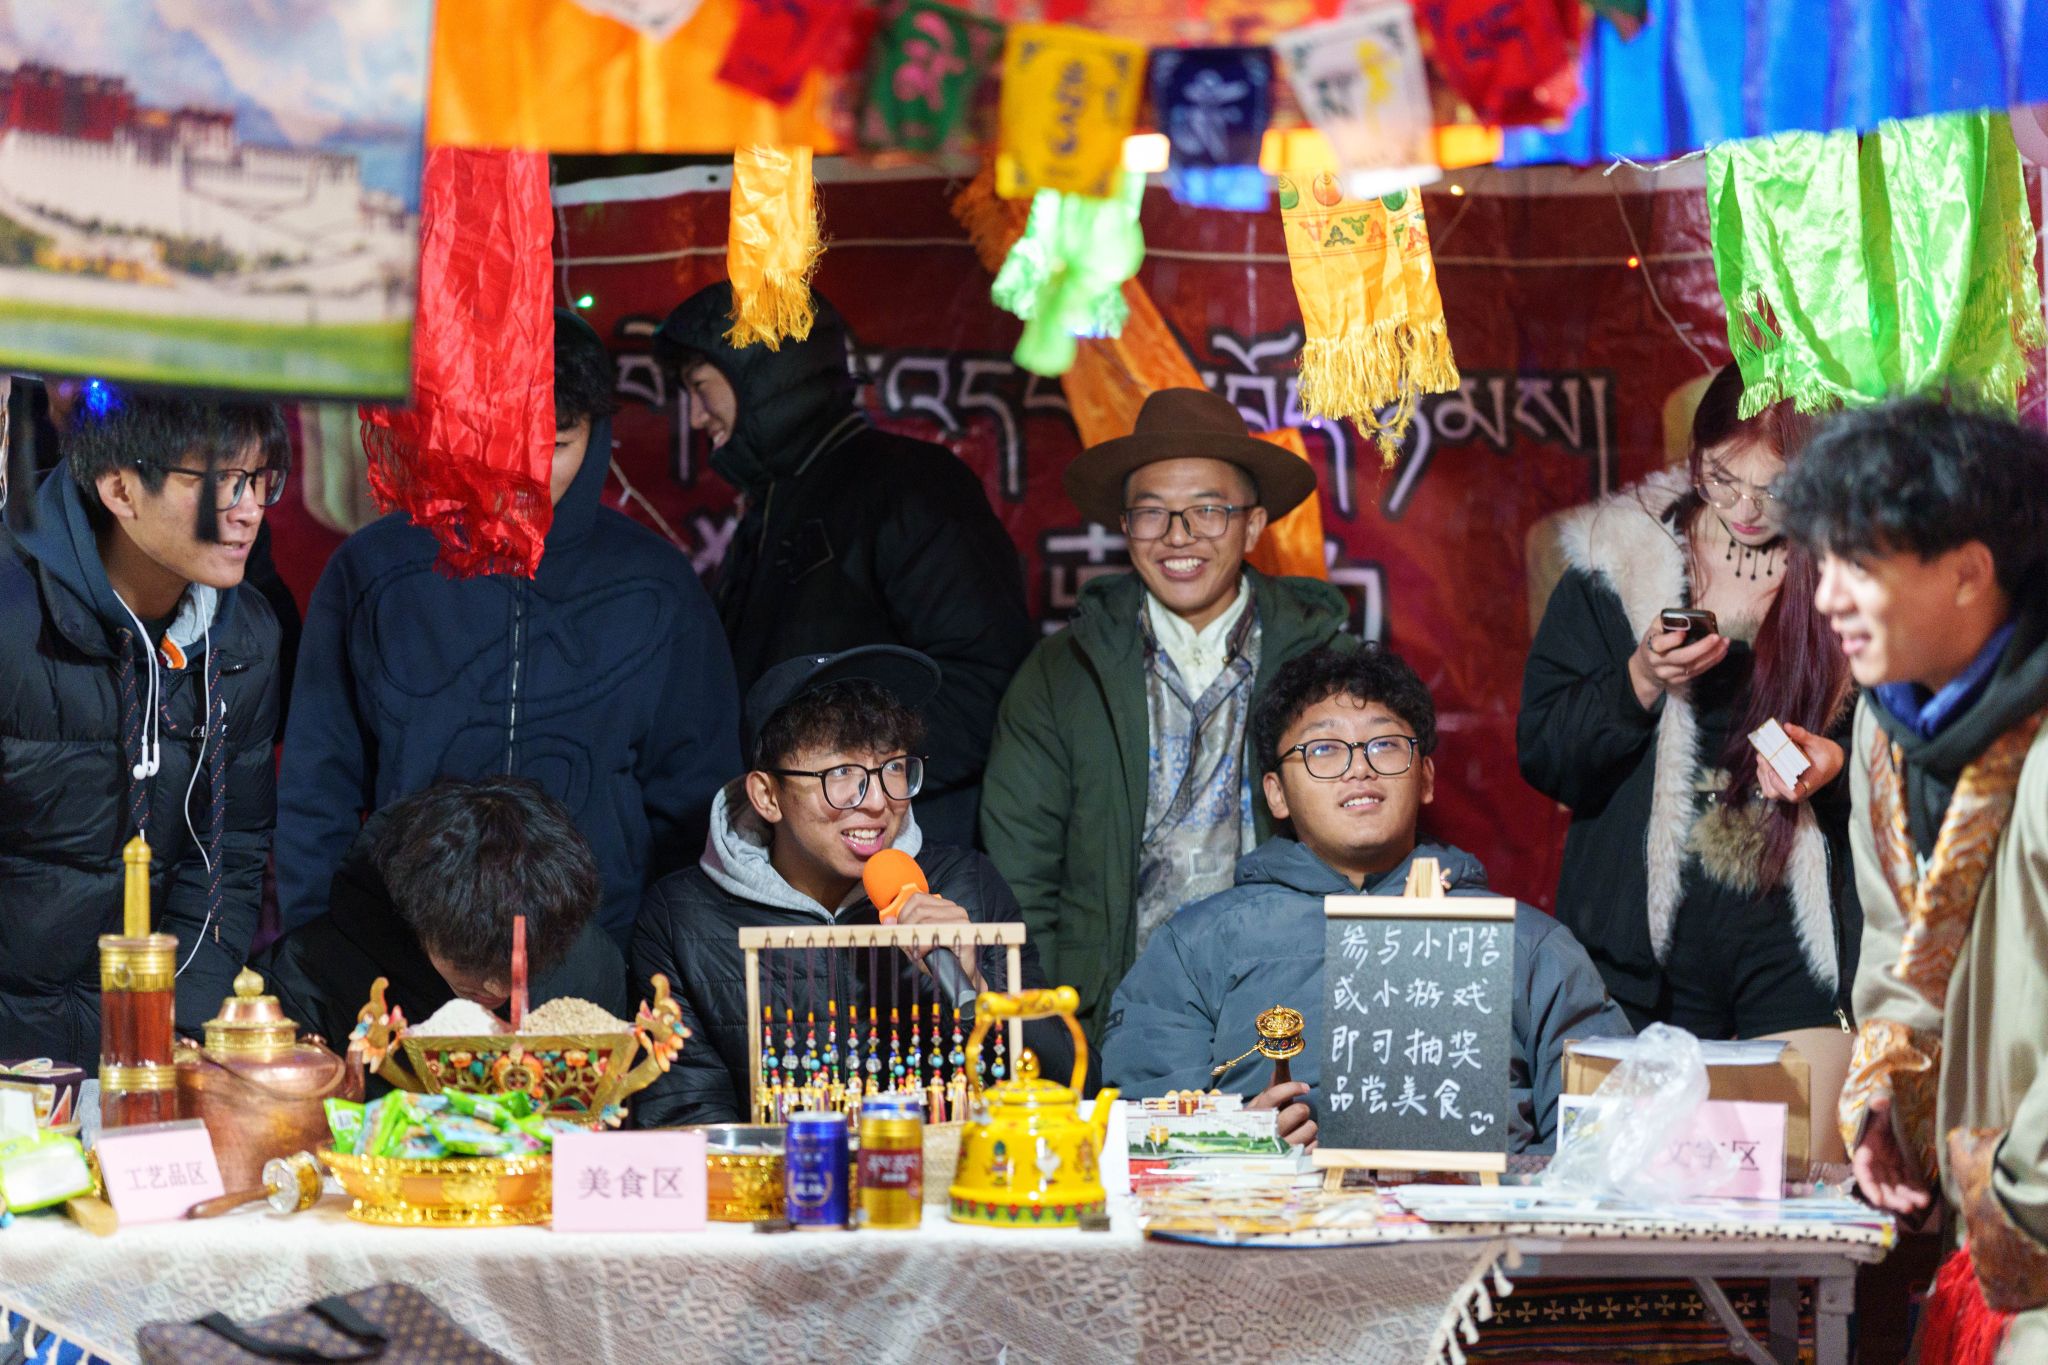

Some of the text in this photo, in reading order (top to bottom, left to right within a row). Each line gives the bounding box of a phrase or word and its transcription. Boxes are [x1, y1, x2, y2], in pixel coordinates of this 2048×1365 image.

[1340, 925, 1500, 970] 参与小问答
[1333, 973, 1492, 1015] 或小游戏
[1331, 1025, 1483, 1073] 即可抽奖
[1330, 1075, 1463, 1120] 品尝美食
[124, 1161, 208, 1191] 工艺品区
[578, 1165, 683, 1199] 美食区
